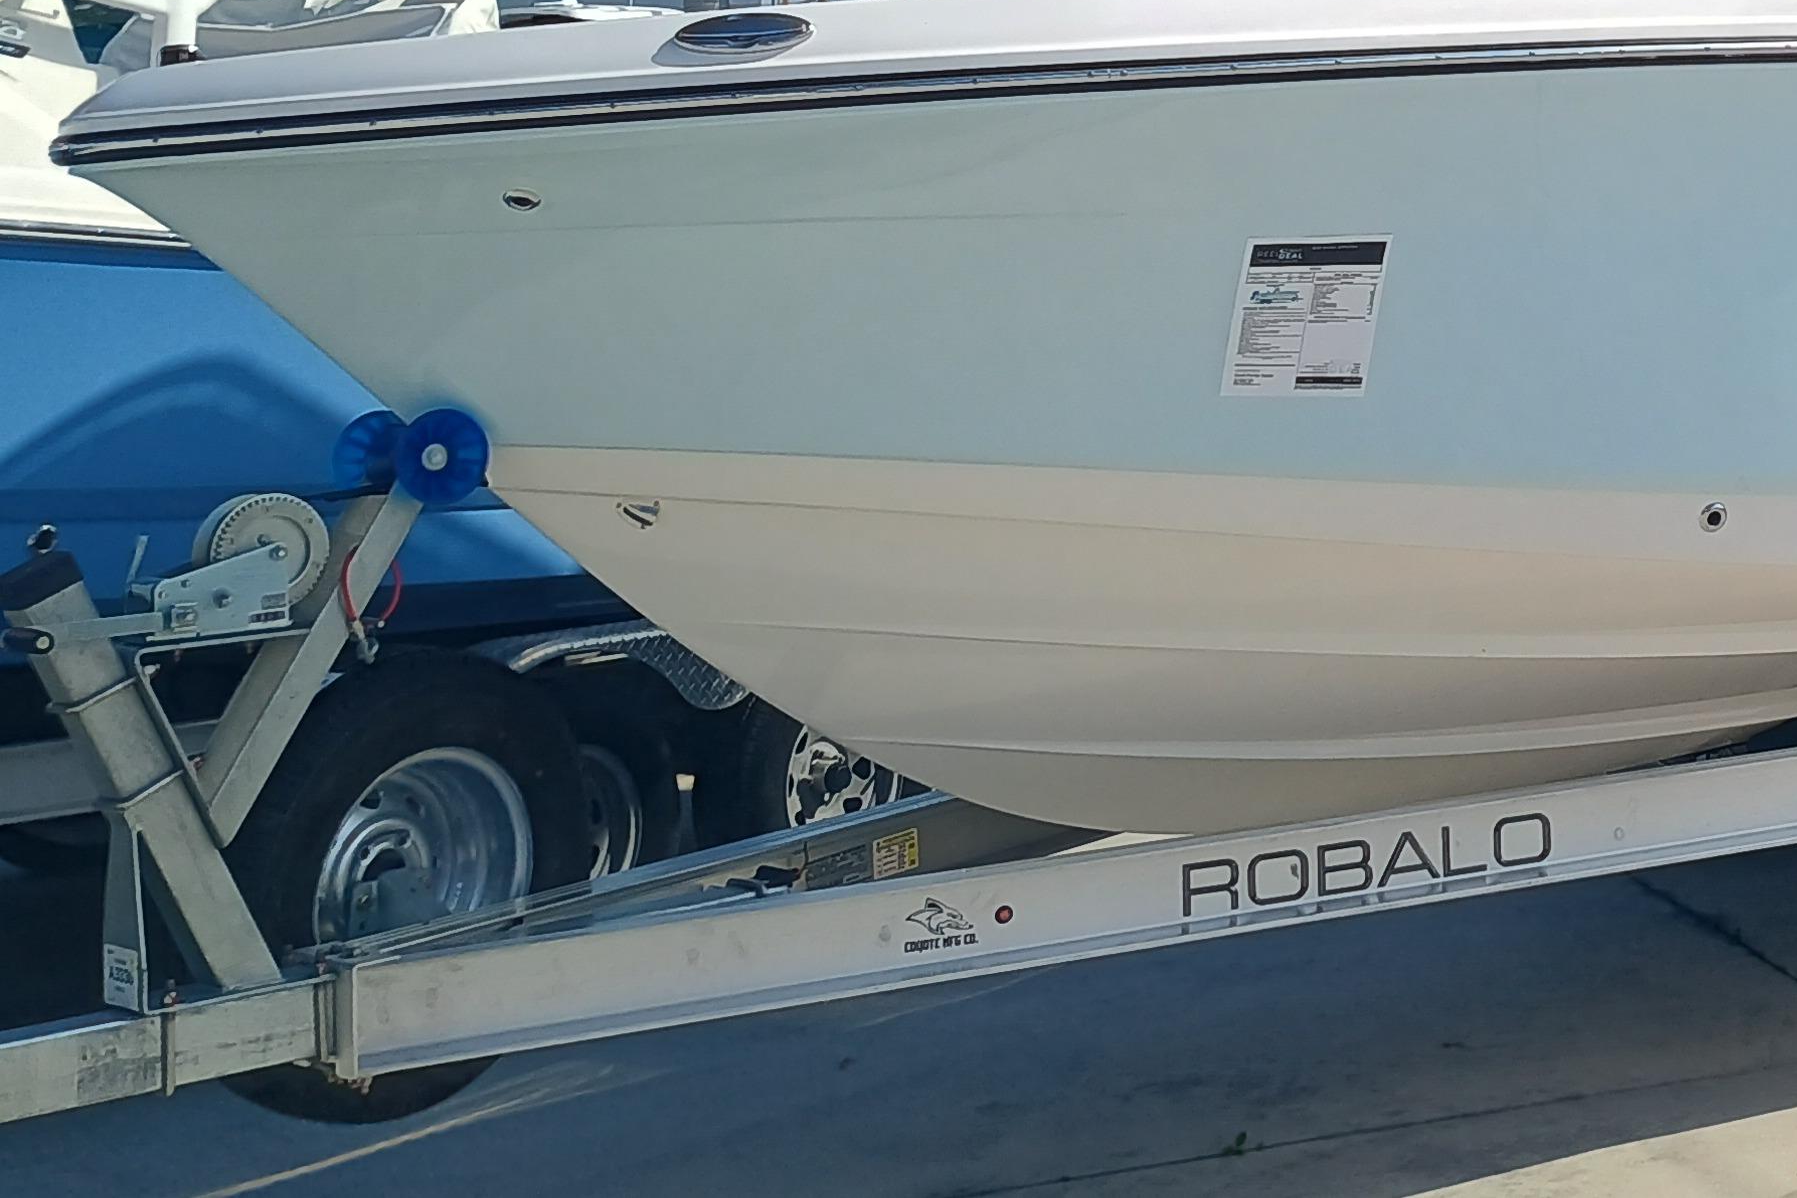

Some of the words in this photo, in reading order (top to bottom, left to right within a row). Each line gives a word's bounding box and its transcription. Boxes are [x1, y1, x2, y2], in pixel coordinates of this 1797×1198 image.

[1182, 813, 1551, 917] ROBALO
[904, 937, 941, 953] COYOTE
[963, 933, 979, 945] CO.
